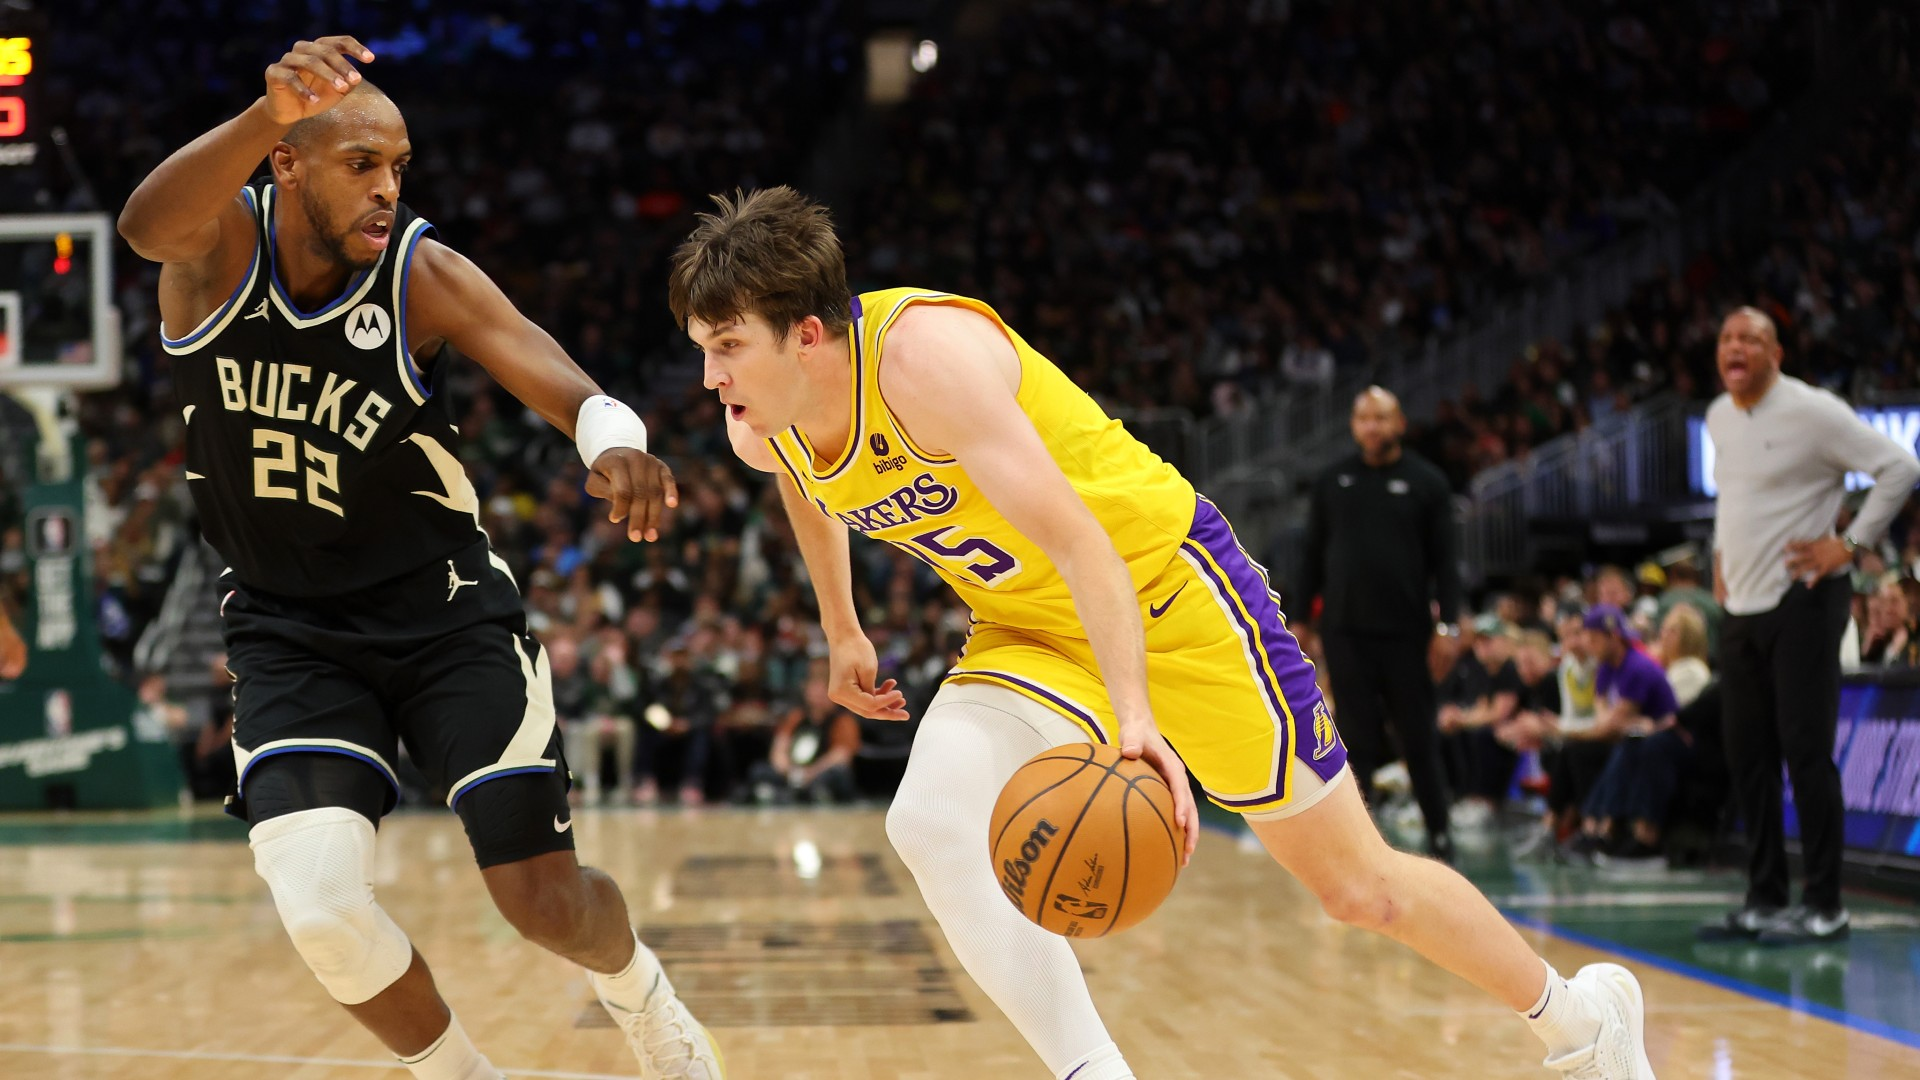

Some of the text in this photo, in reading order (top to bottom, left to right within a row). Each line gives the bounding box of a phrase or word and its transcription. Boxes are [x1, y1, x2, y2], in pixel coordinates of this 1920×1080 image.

[215, 356, 394, 452] BUCKS
[252, 428, 345, 518] 22
[872, 455, 908, 475] bibigo
